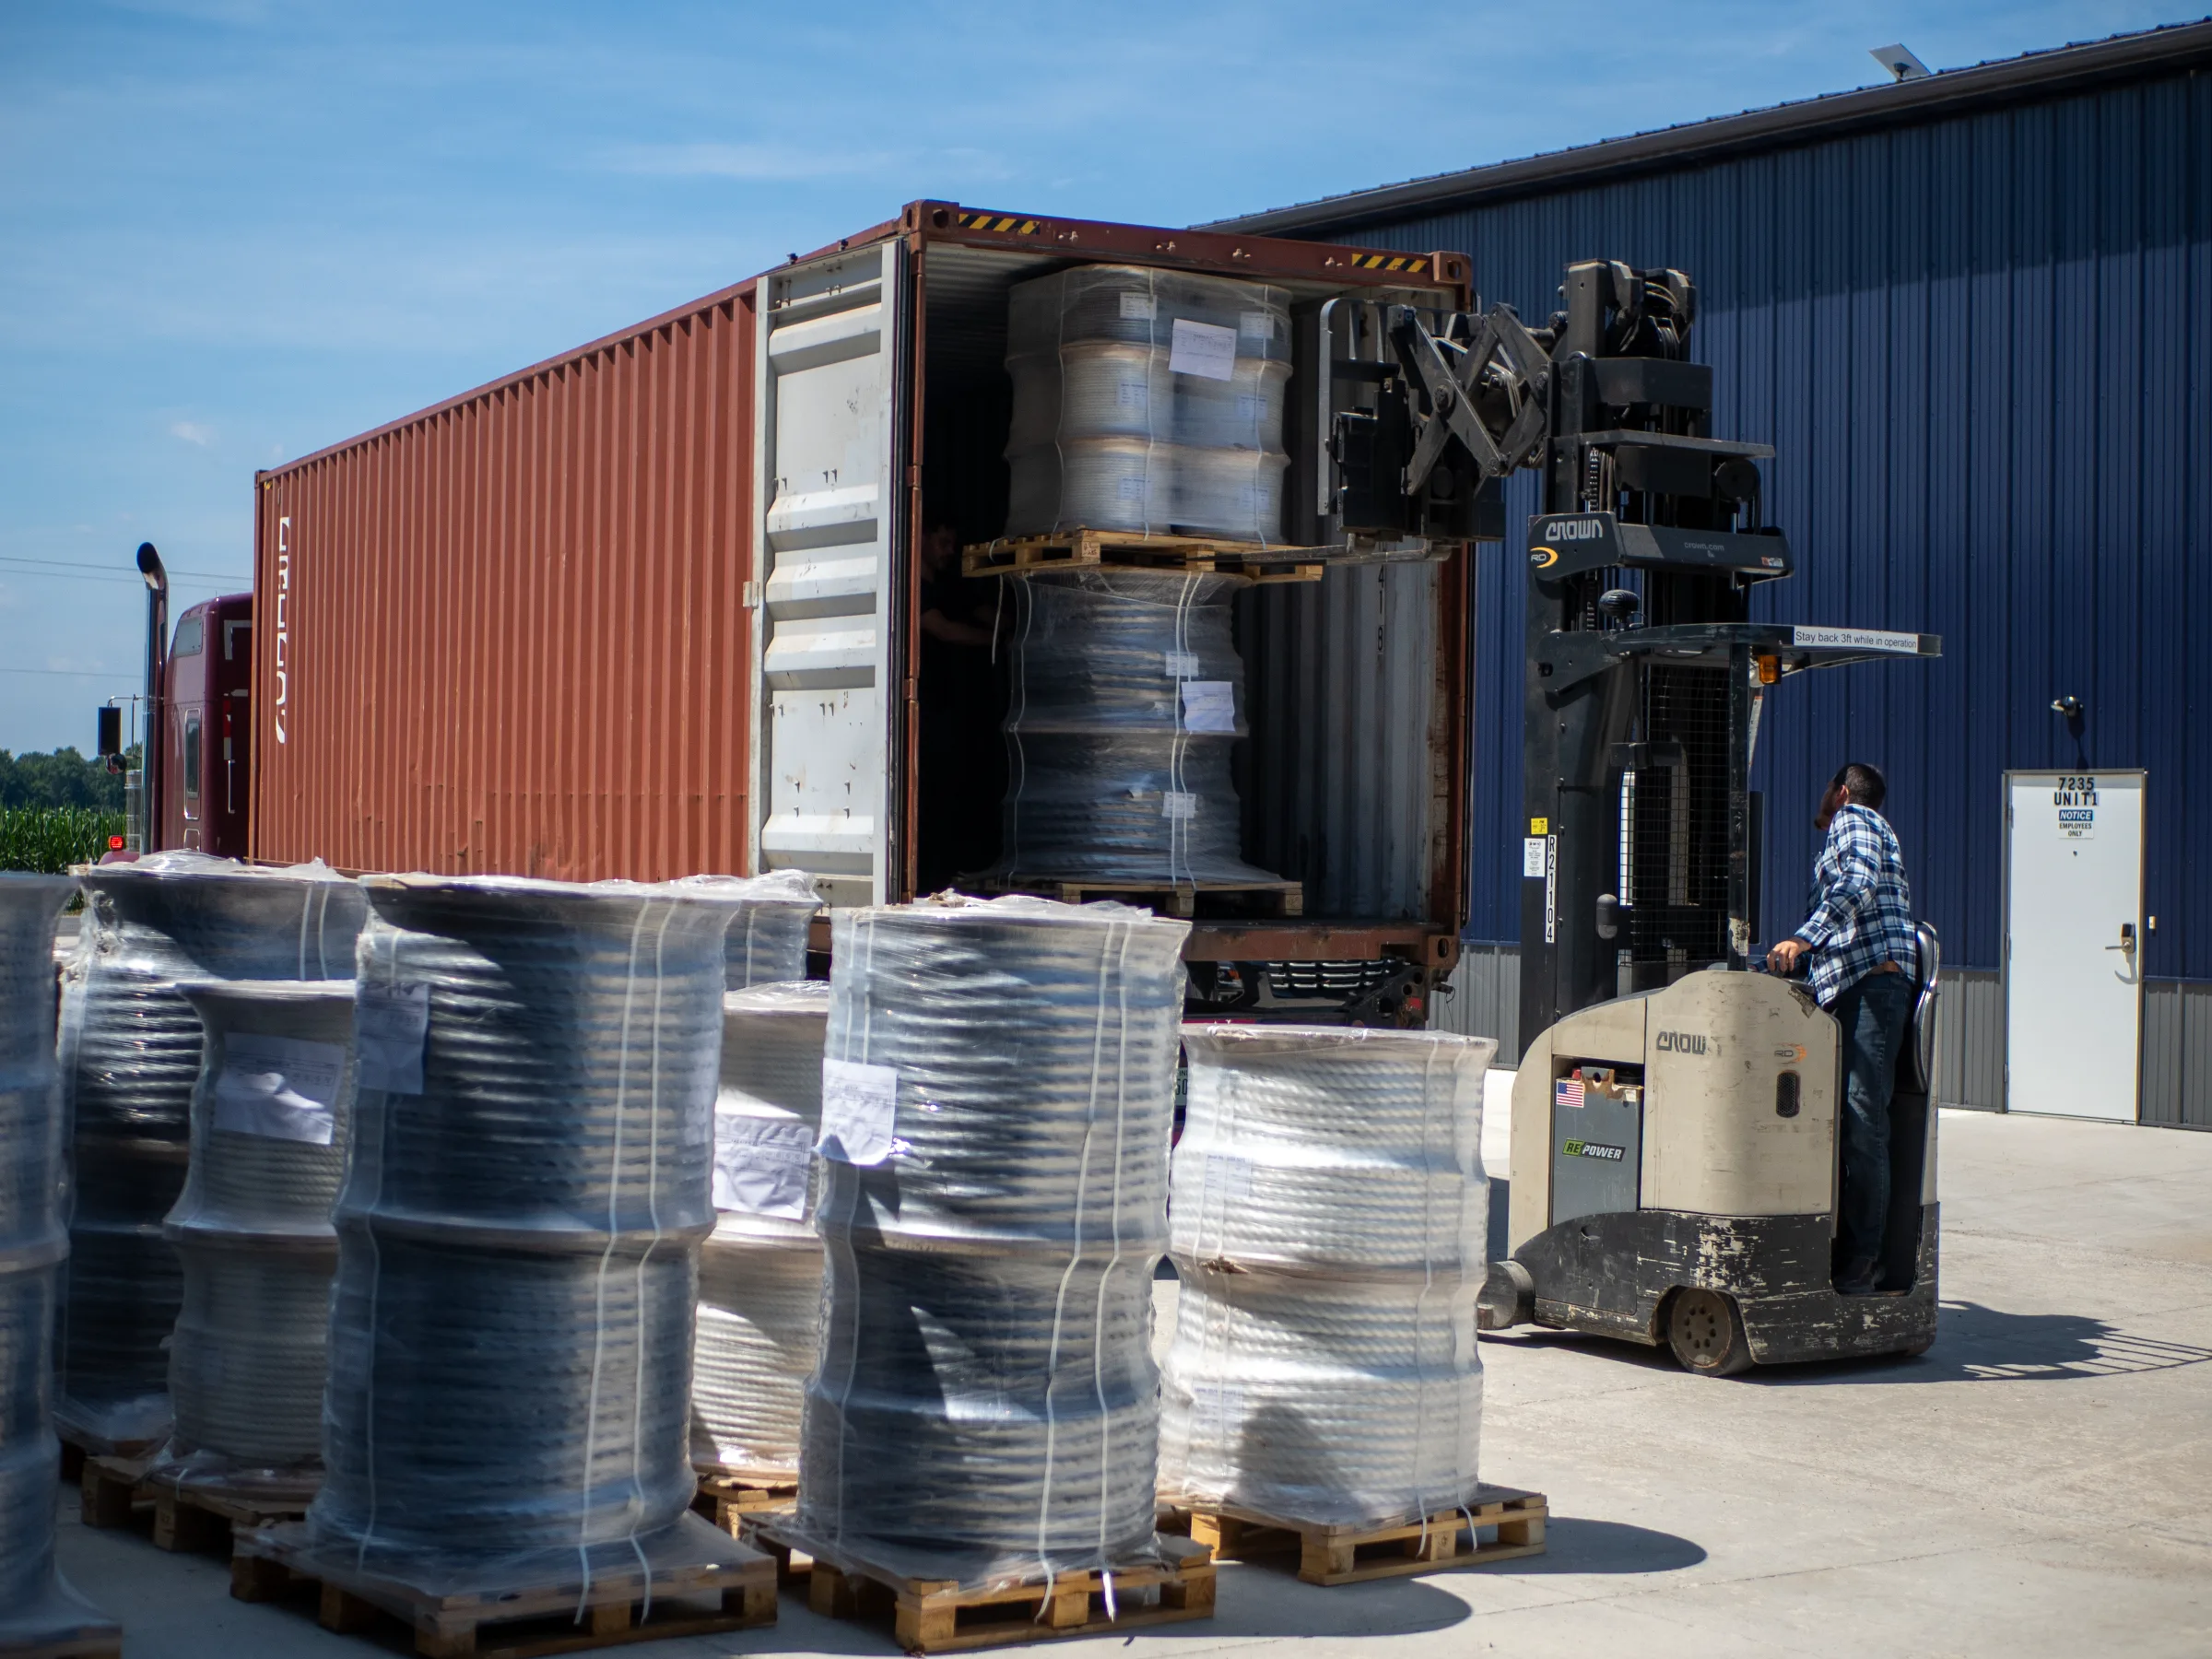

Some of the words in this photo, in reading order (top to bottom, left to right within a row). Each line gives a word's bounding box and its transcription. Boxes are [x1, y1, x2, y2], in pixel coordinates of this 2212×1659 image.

[1546, 519, 1603, 541] CROWN
[1684, 541, 1724, 551] crown.com
[1795, 631, 1816, 643] Stay
[1818, 632, 1839, 643] back
[1841, 633, 1852, 643] 3ft
[1853, 634, 1874, 645] while
[1876, 637, 1882, 645] in
[1884, 638, 1916, 649] operation
[2058, 777, 2094, 791] 7235
[2060, 811, 2091, 820] NOTICE
[1547, 836, 1556, 942] R21104
[1656, 1031, 1707, 1055] CROW
[1773, 1050, 1794, 1058] RD
